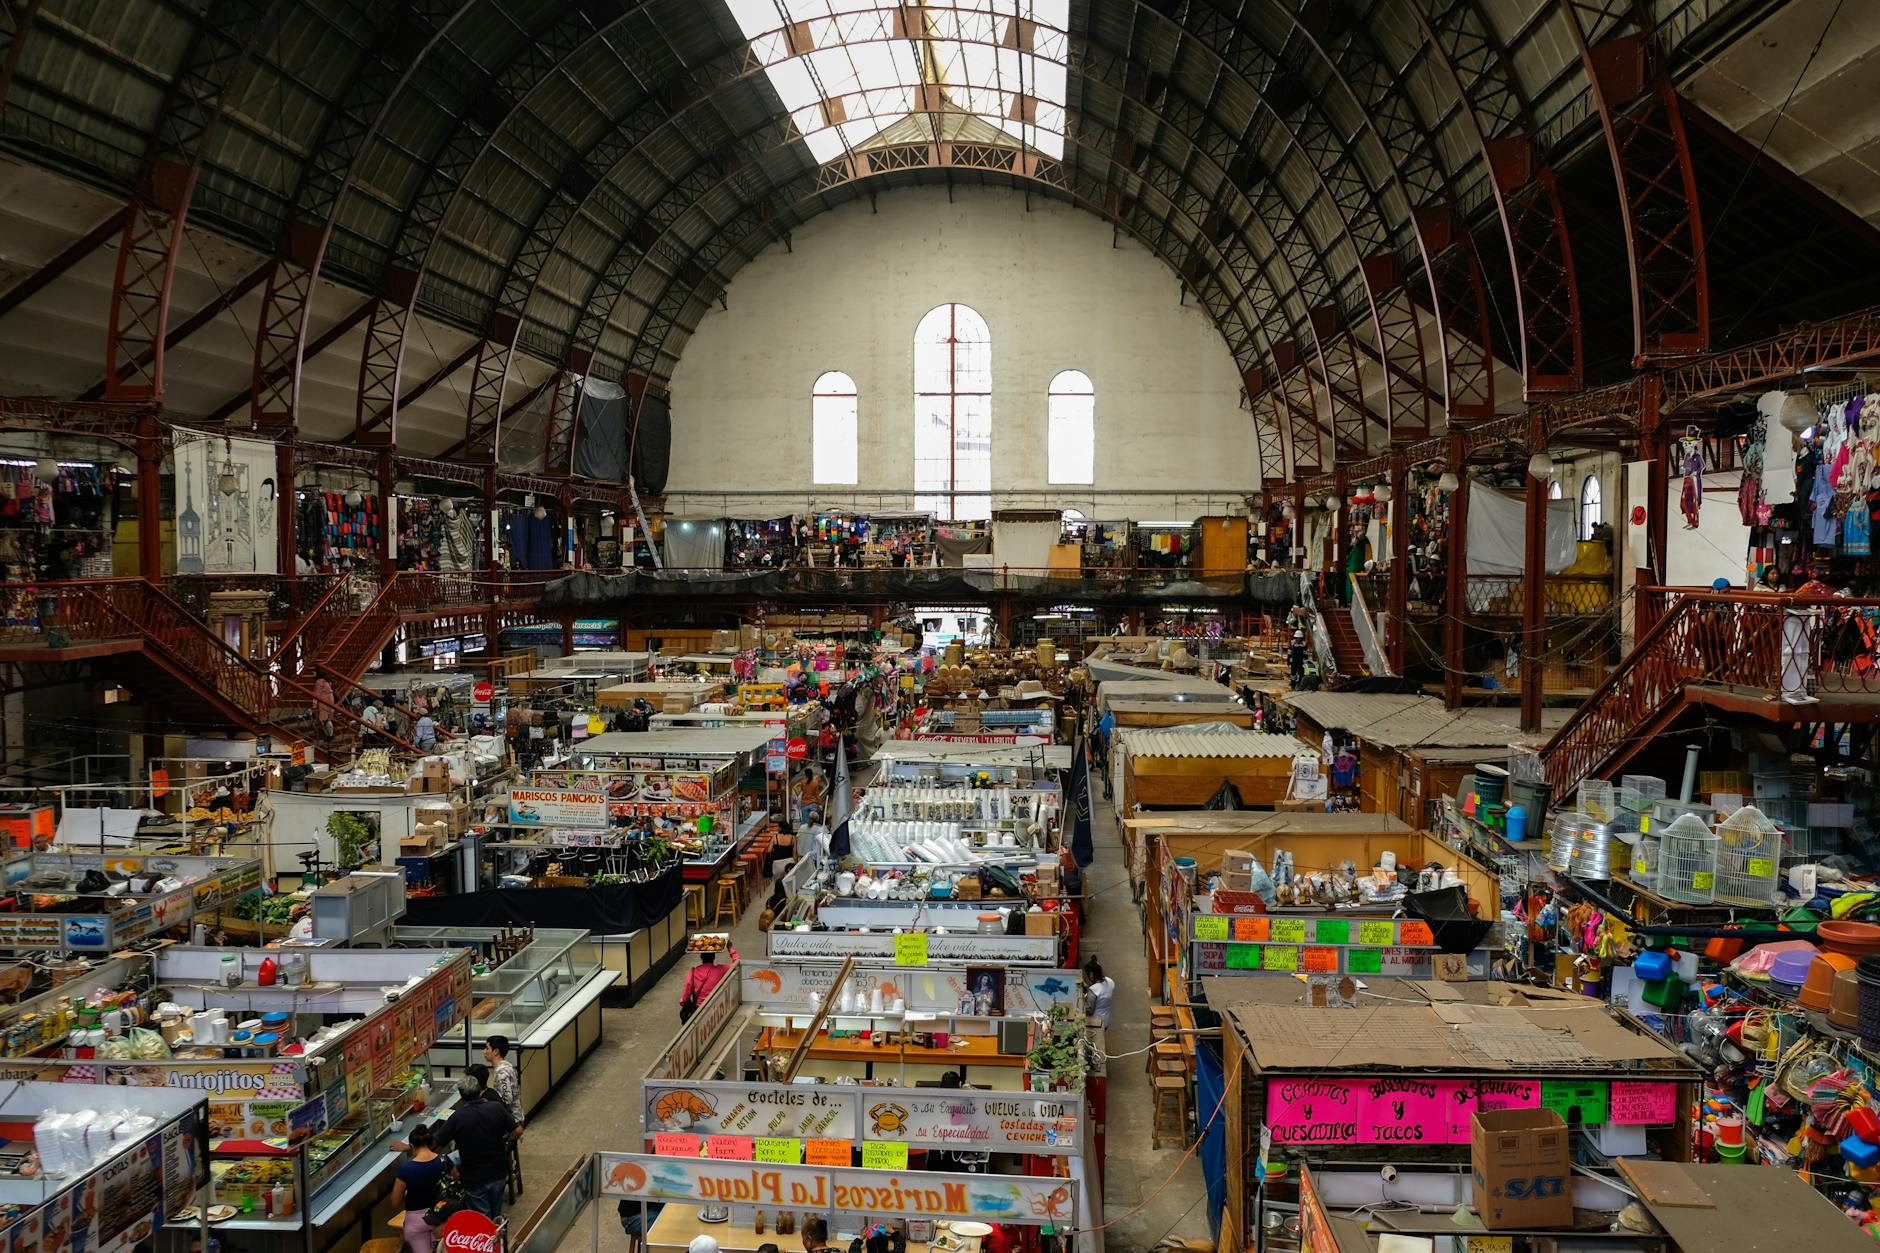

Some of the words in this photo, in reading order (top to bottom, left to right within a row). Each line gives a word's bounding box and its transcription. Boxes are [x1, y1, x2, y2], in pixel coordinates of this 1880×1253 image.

[512, 790, 557, 801] MARISCOS
[561, 793, 605, 804] PANCHO'S
[775, 938, 808, 949] Dulce
[809, 937, 833, 949] vida
[926, 940, 950, 951] ulce
[952, 940, 977, 951] vida
[1204, 951, 1224, 959] SOPA
[168, 1070, 265, 1096] Antojitos
[1367, 1078, 1437, 1101] BURRITOS
[748, 1089, 806, 1107] Cocteles
[1281, 1081, 1350, 1105] GORDITAS
[720, 1102, 746, 1130] CAMARON
[939, 1101, 978, 1120] Exquisito
[984, 1101, 1020, 1117] VUELVE
[1028, 1109, 1036, 1118] la
[1040, 1102, 1065, 1118] VIDA
[736, 1108, 758, 1131] OSTION
[767, 1110, 787, 1132] PULPO
[798, 1112, 816, 1135] JAIBA
[815, 1109, 839, 1135] CARACOL
[1000, 1118, 1045, 1132] tostadas
[932, 1125, 990, 1142] Especialidad
[1006, 1132, 1047, 1143] CEVICHE
[1371, 1124, 1423, 1141] TACOS
[102, 1157, 129, 1182] TORTAS
[445, 1229, 496, 1253] Coca-Cola
